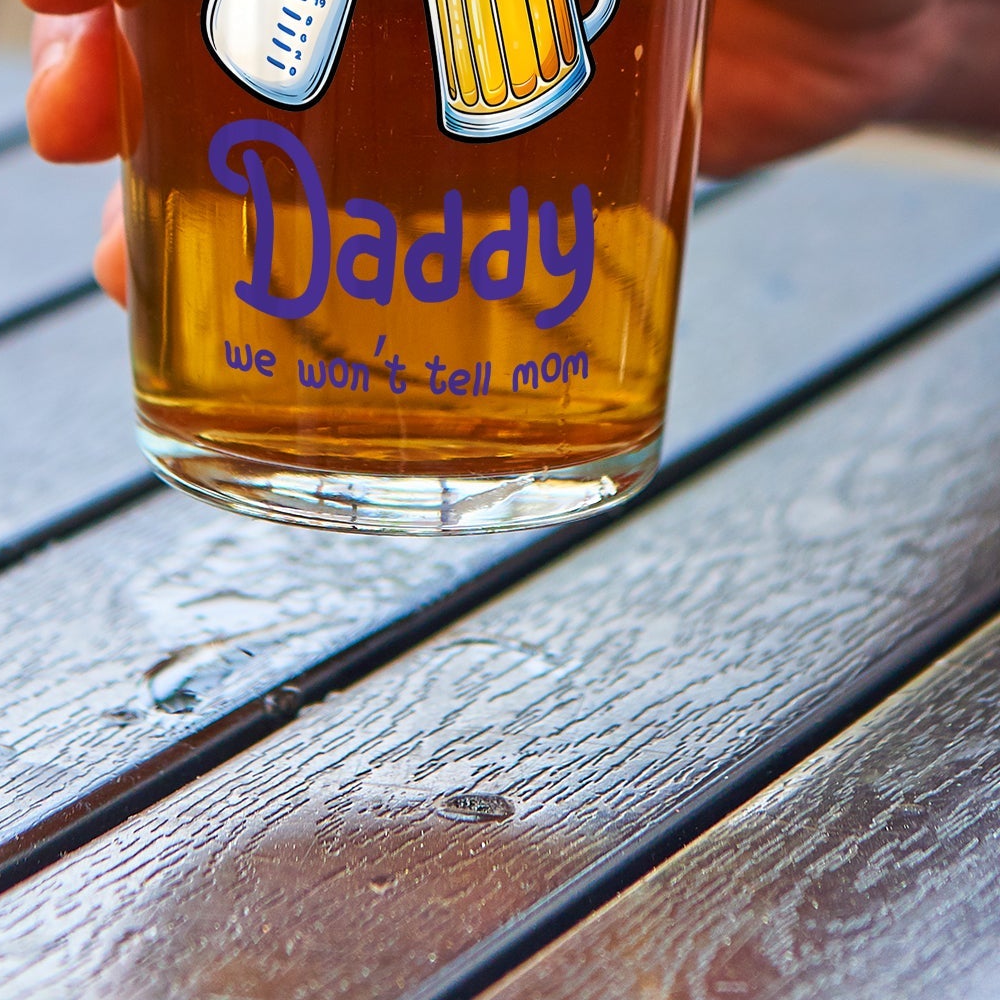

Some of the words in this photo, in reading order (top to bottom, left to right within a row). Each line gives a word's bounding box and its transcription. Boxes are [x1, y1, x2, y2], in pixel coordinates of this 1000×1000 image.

[208, 118, 595, 330] Daddy
[224, 340, 277, 378] we
[298, 334, 407, 394] won't
[425, 355, 492, 397] tell
[512, 350, 589, 392] mom
